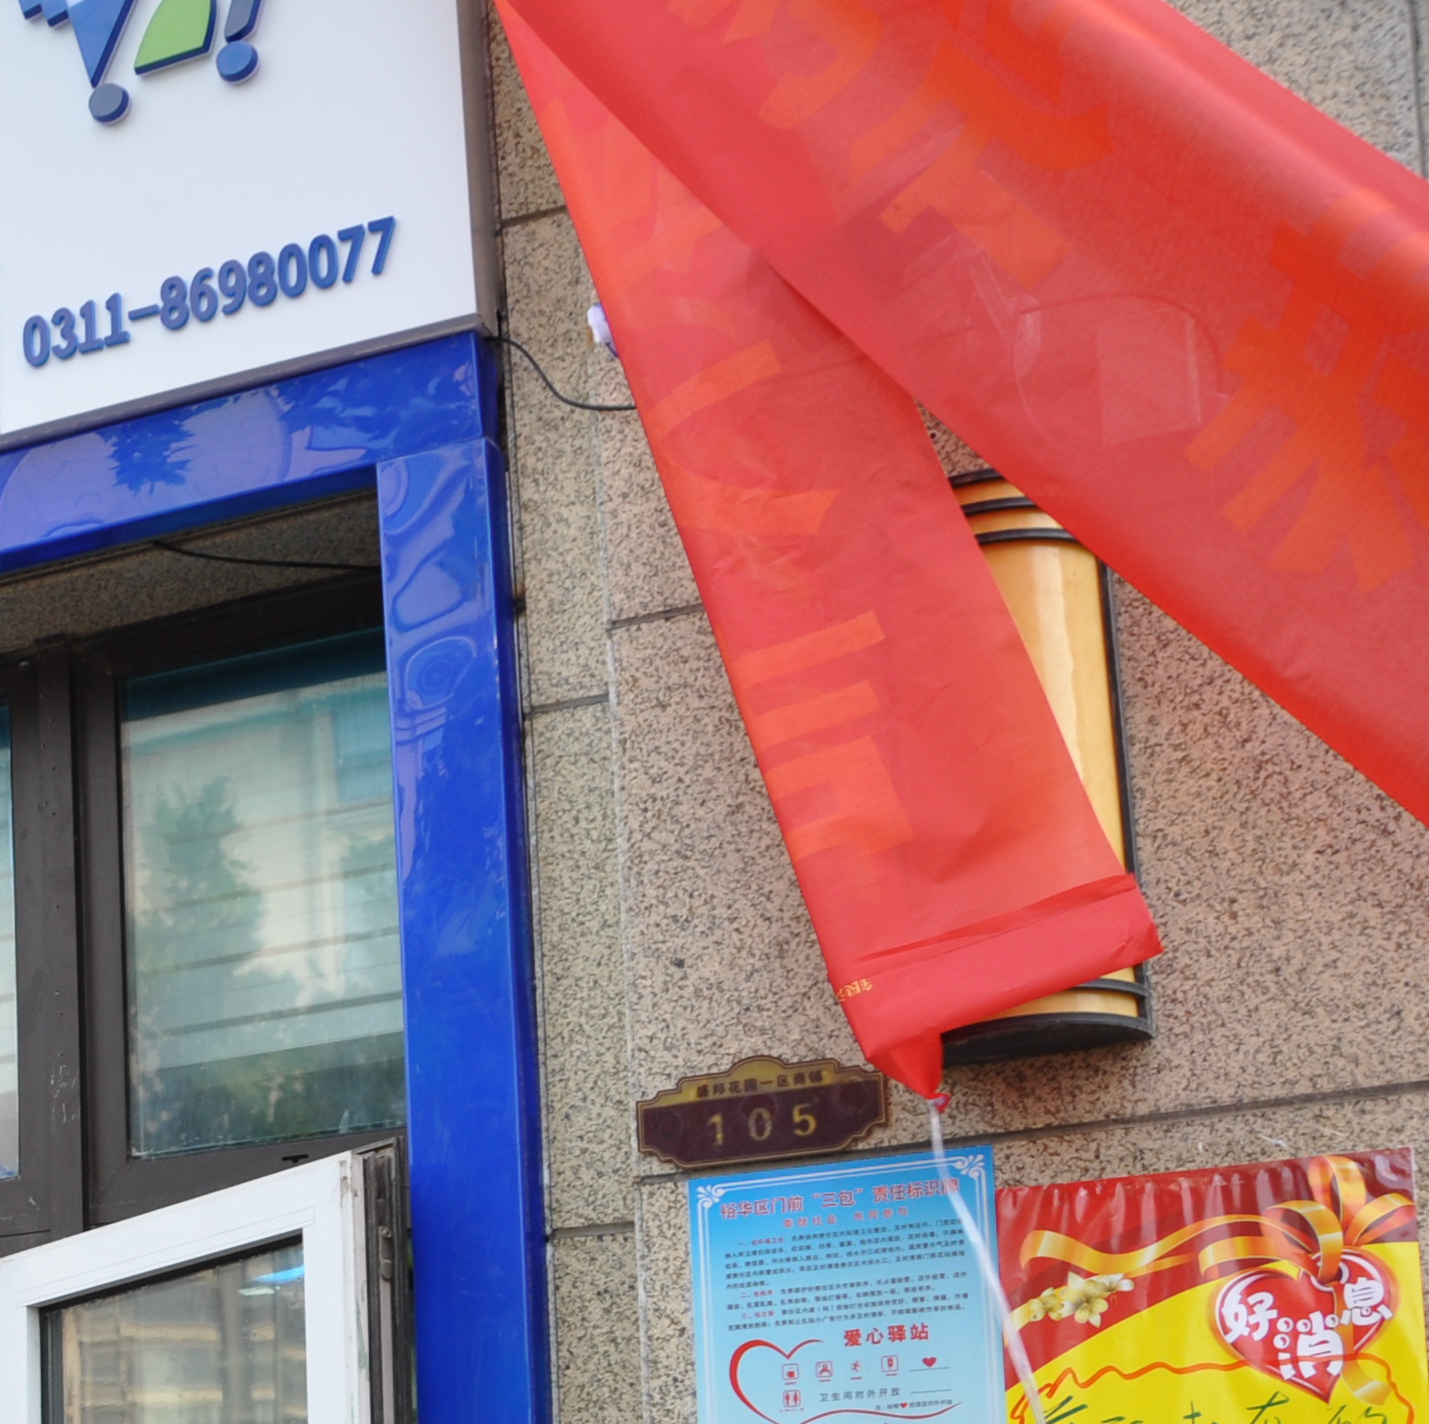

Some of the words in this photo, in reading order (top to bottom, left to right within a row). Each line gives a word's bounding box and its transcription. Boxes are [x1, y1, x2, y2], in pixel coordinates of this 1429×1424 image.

[22, 214, 396, 367] 0311-86980077
[706, 1103, 817, 1147] 105
[844, 1322, 930, 1348] 爱心驿站
[1221, 1277, 1393, 1380] 好消息
[819, 1387, 902, 1402] 卫生间对外开放
